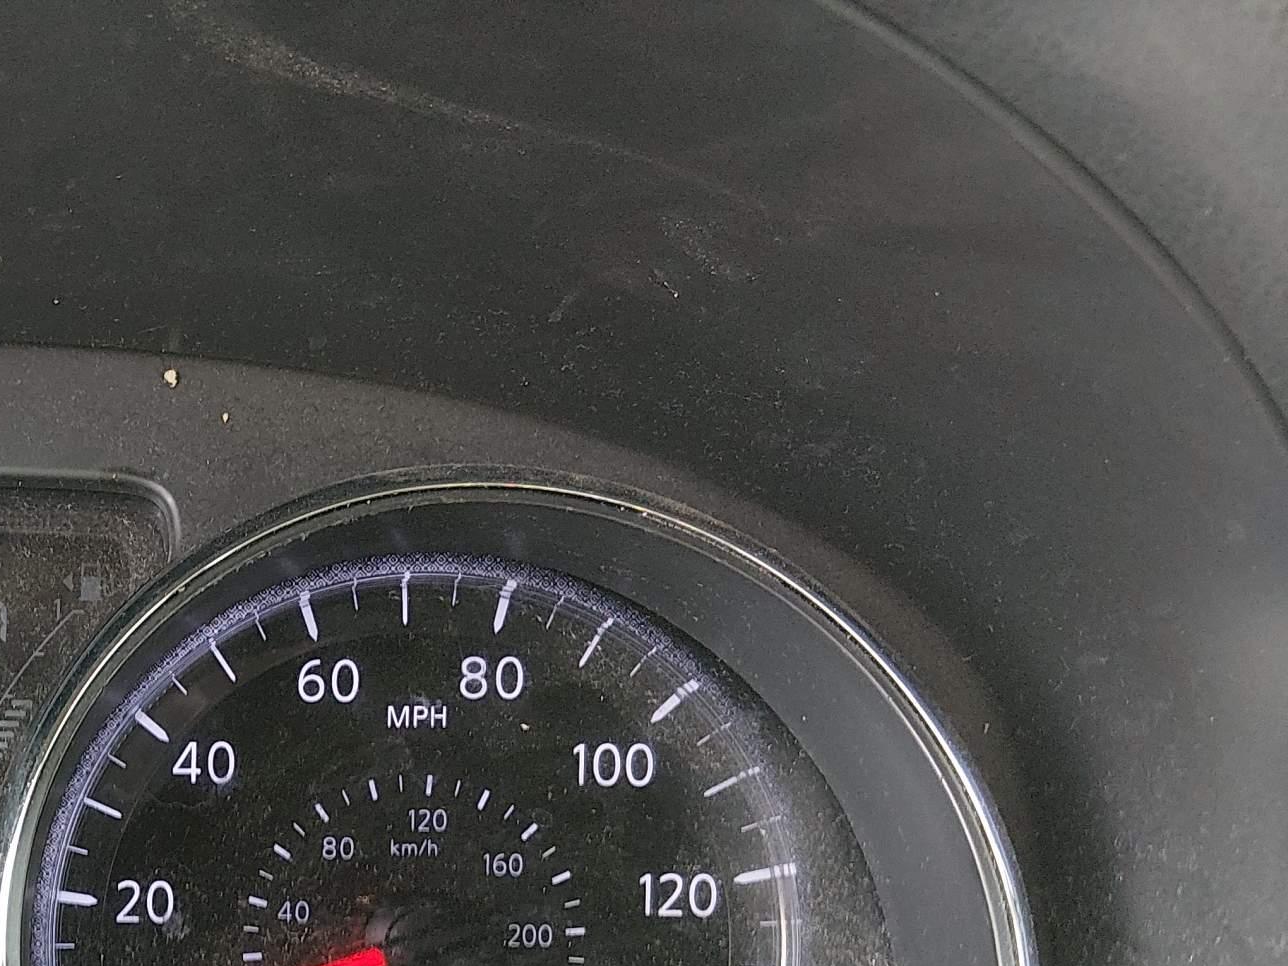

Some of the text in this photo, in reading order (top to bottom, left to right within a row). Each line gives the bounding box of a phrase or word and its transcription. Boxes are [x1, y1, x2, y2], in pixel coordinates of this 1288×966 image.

[296, 658, 361, 704] 60
[458, 656, 524, 701] 80
[385, 704, 448, 729] MPH
[171, 740, 236, 786] 40
[572, 743, 655, 788] 100
[407, 808, 448, 832] 120
[321, 835, 356, 861] 80
[389, 837, 440, 859] km/h
[482, 852, 524, 879] 160
[115, 880, 175, 925] 20
[639, 872, 718, 919] 120
[277, 900, 310, 924] 40
[507, 923, 554, 949] 200
